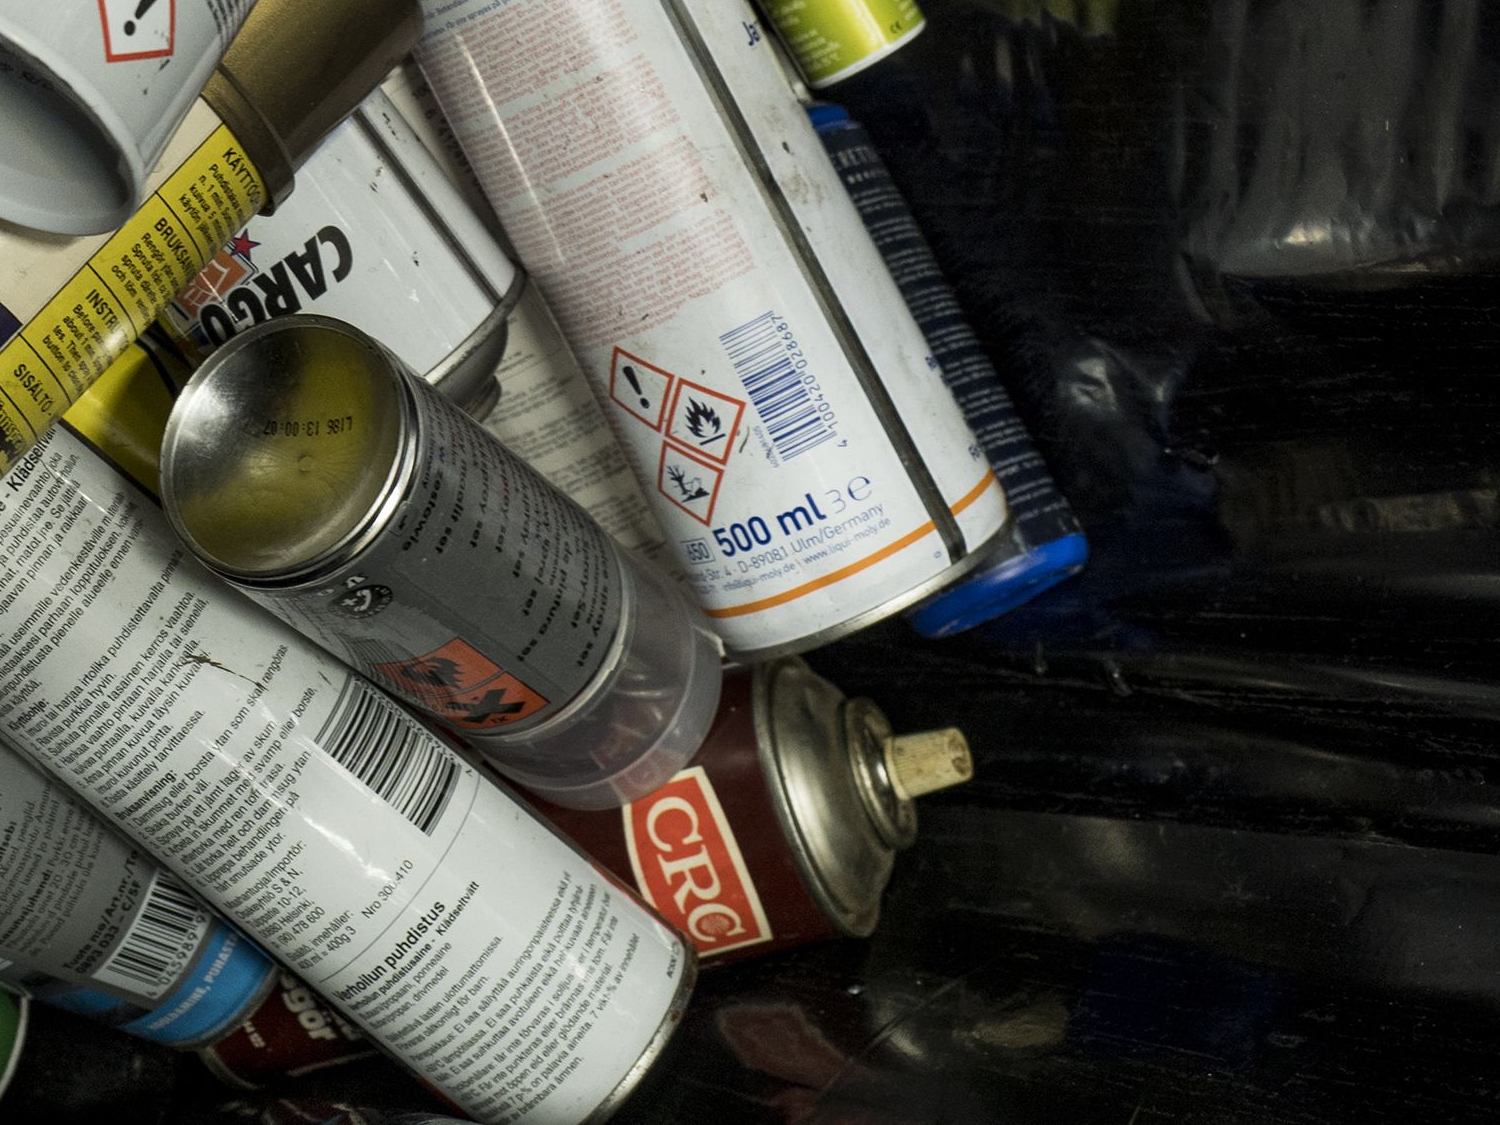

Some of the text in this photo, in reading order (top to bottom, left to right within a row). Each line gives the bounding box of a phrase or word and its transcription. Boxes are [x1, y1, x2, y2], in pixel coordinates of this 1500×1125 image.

[195, 223, 360, 349] CARGO
[10, 363, 57, 415] SISÄLTÖ
[772, 314, 849, 450] 4 100420 028687
[3, 504, 46, 556] puhdistaa
[713, 513, 772, 559] 500
[777, 493, 826, 537] ml
[790, 498, 885, 557] Ulm/Germany
[47, 539, 134, 647] pienelle alueelle ennen
[53, 682, 86, 714] harjaa
[77, 653, 110, 687] irtolika
[105, 579, 167, 657] puhdistettavalta
[76, 697, 113, 735] pinnalle
[105, 658, 145, 701] tasainen
[139, 625, 169, 662] kerros
[162, 586, 196, 629] vaahtoa.
[82, 716, 116, 746] vaahto
[109, 681, 148, 721] pintaan
[140, 646, 176, 687] harjalla
[167, 632, 184, 650] tai
[59, 692, 99, 729] purkkia
[152, 705, 206, 763] tarvittaessa.
[361, 898, 382, 919] Nro
[646, 792, 745, 945] CRC
[329, 897, 449, 1002] Verhoilun puhdistus
[375, 940, 435, 995] puhdistusaine
